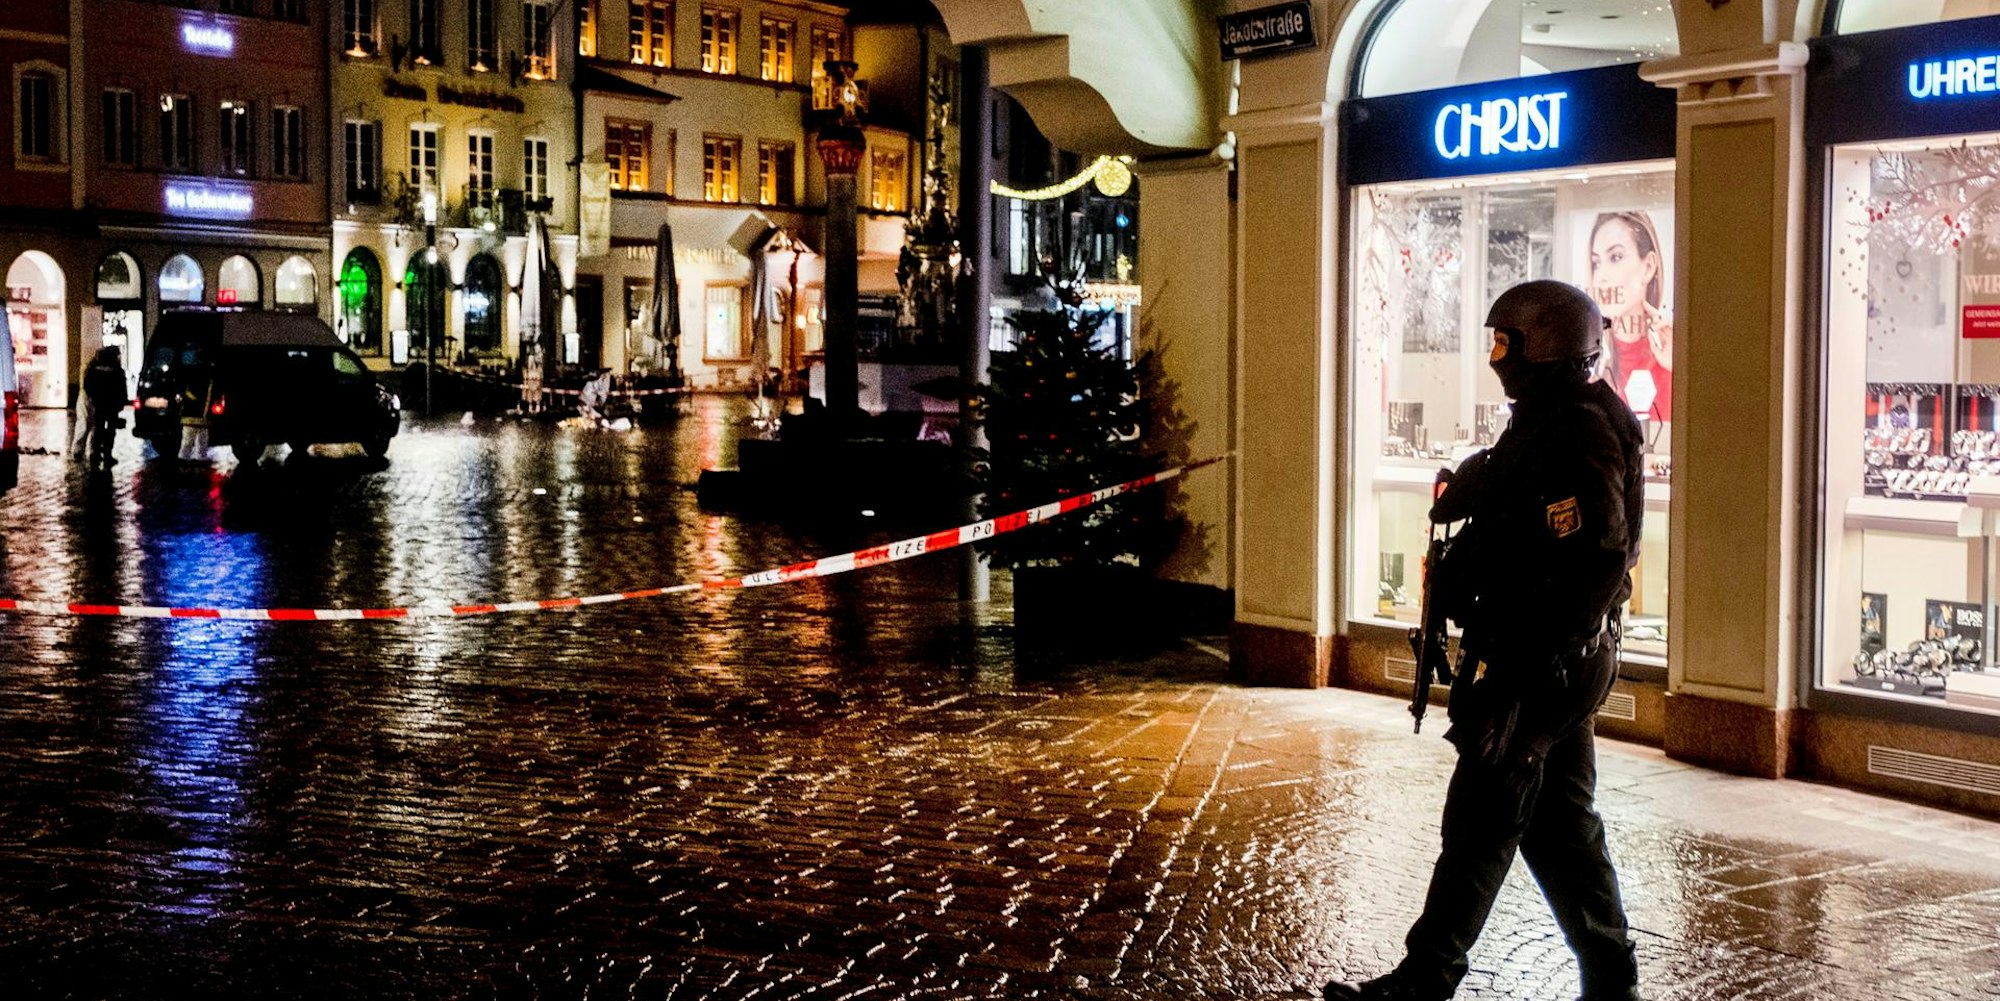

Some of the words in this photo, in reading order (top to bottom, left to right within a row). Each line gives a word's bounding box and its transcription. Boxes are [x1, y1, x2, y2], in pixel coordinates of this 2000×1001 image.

[1223, 9, 1304, 45] Jakobstraße
[1909, 55, 2000, 99] UHRE
[1435, 91, 1568, 160] CHRIST
[1611, 314, 1655, 334] AHR
